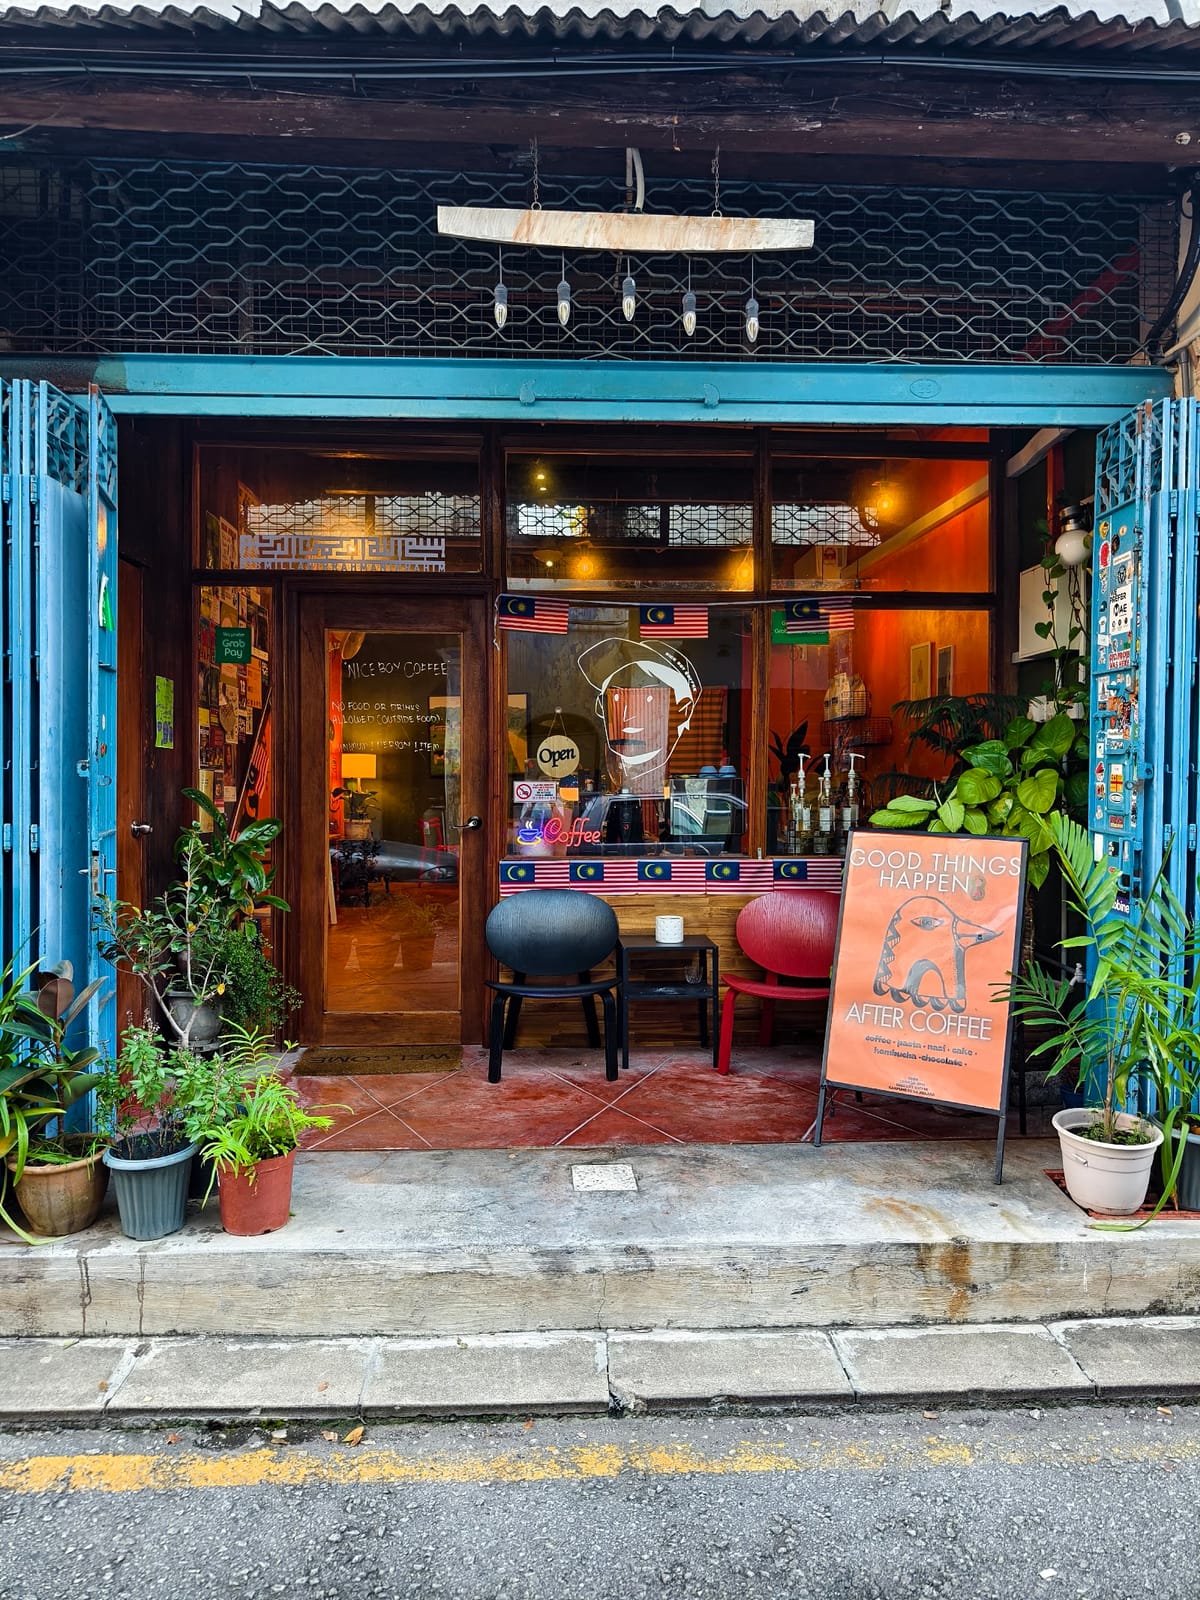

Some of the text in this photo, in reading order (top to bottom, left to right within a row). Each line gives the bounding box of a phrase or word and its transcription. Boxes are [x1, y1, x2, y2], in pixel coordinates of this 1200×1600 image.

[222, 639, 246, 648] Grab
[224, 648, 243, 659] Pay
[378, 662, 400, 674] BOY
[332, 701, 420, 712] NO FOOD OR DRINKS
[333, 714, 374, 724] ALLOWED
[539, 746, 576, 768] Open
[543, 817, 601, 847] Coffee
[850, 848, 1022, 877] GOOD THINGS
[879, 869, 970, 894] HAPPEN
[845, 1002, 993, 1041] AFTER COFFEE
[865, 1034, 892, 1045] coffee
[309, 1053, 451, 1063] WELCOME
